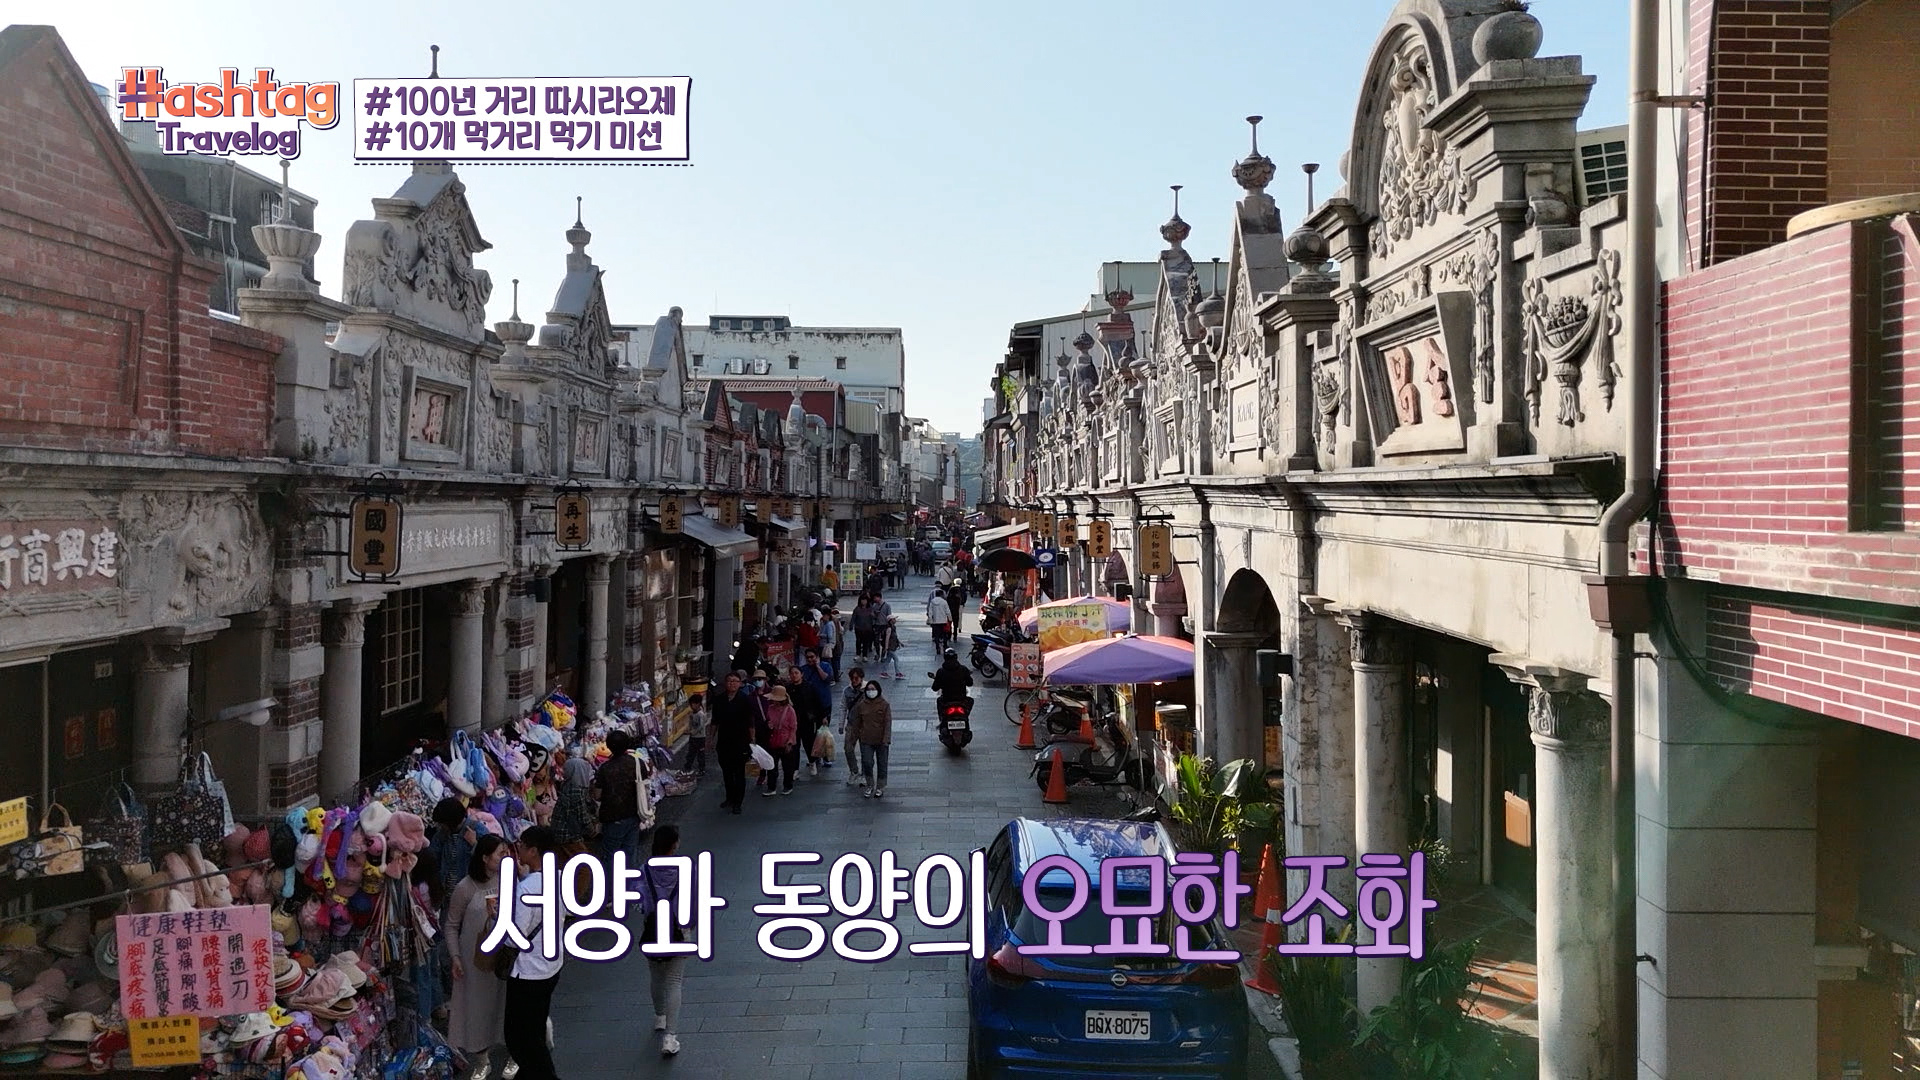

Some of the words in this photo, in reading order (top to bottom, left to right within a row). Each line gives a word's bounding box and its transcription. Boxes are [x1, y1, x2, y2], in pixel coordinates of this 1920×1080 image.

[565, 502, 581, 540] 再生
[665, 502, 678, 530] 再生
[130, 910, 231, 937] 健康鞋墊
[227, 933, 249, 1000] 開過刀
[252, 939, 272, 1011] 很快改善
